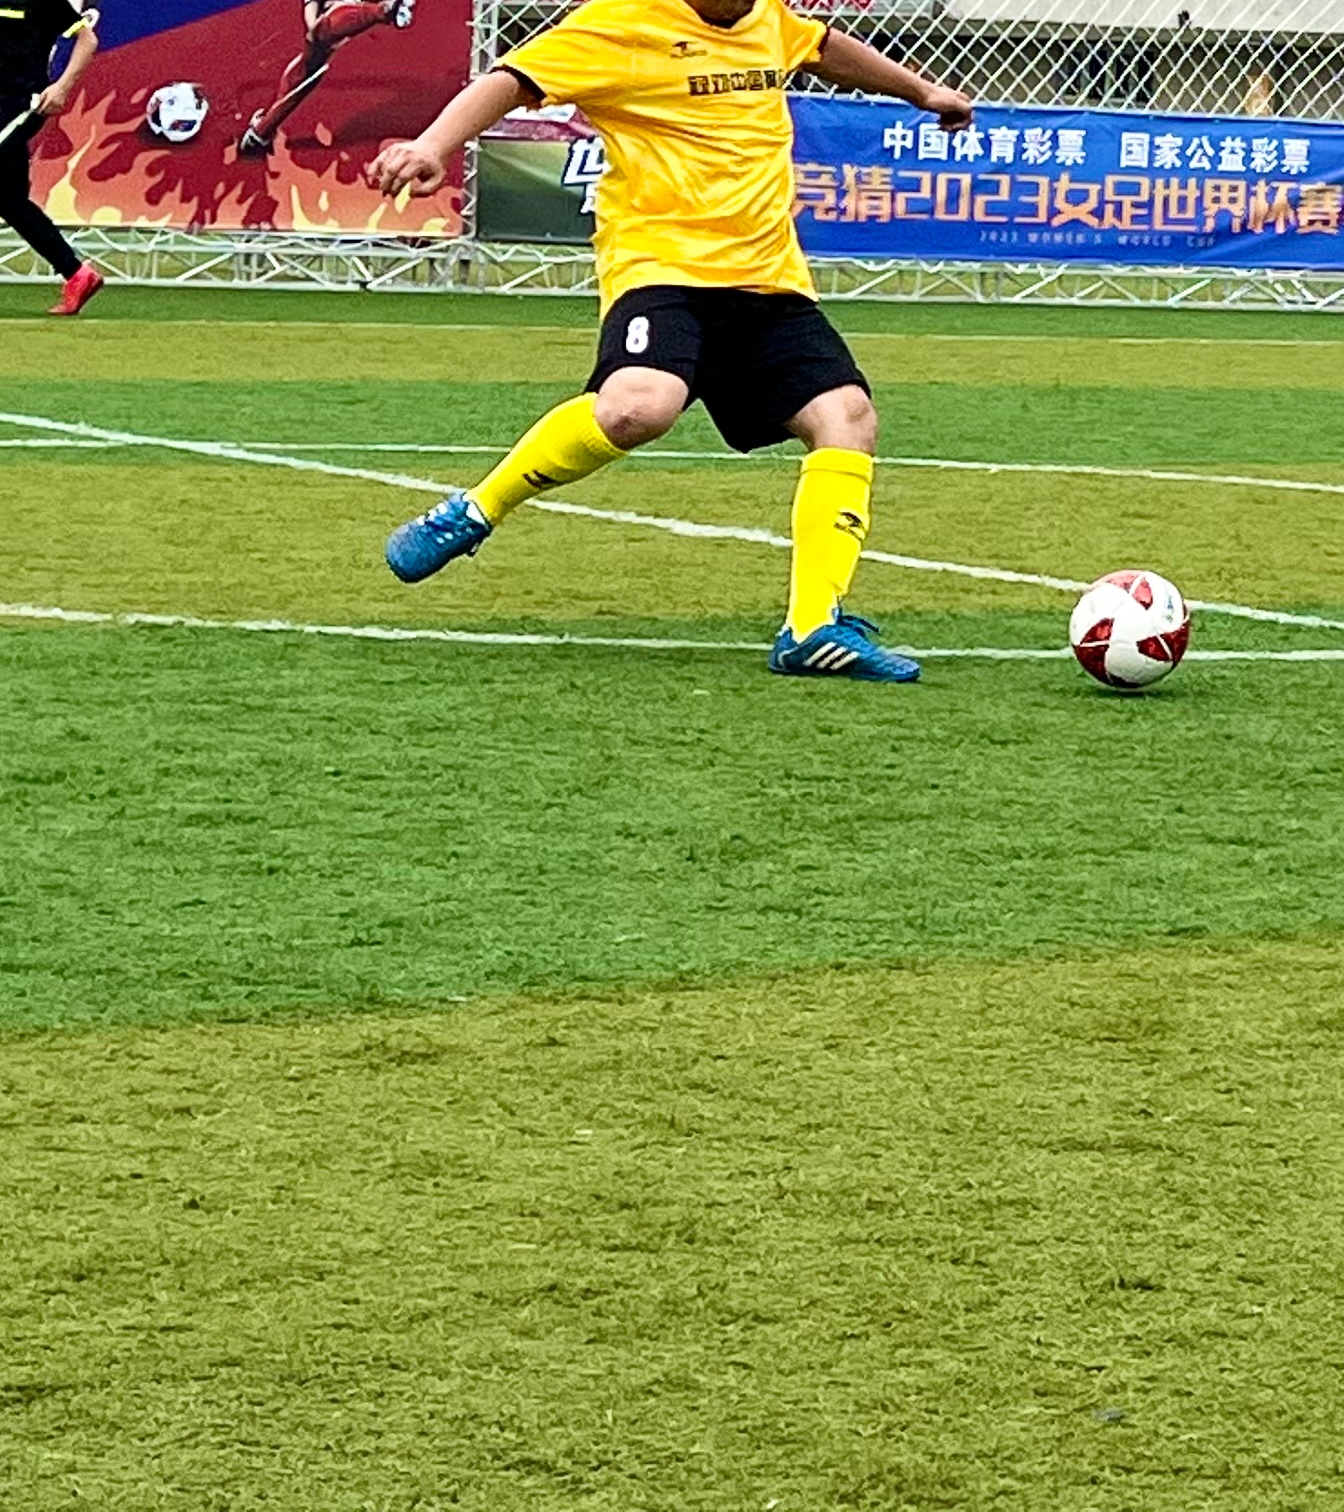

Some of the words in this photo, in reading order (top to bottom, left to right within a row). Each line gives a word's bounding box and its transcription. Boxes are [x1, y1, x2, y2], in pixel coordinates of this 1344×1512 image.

[882, 122, 1087, 166] 中国体育彩票
[1119, 131, 1311, 175] 国家公益彩票
[625, 316, 650, 354] 8
